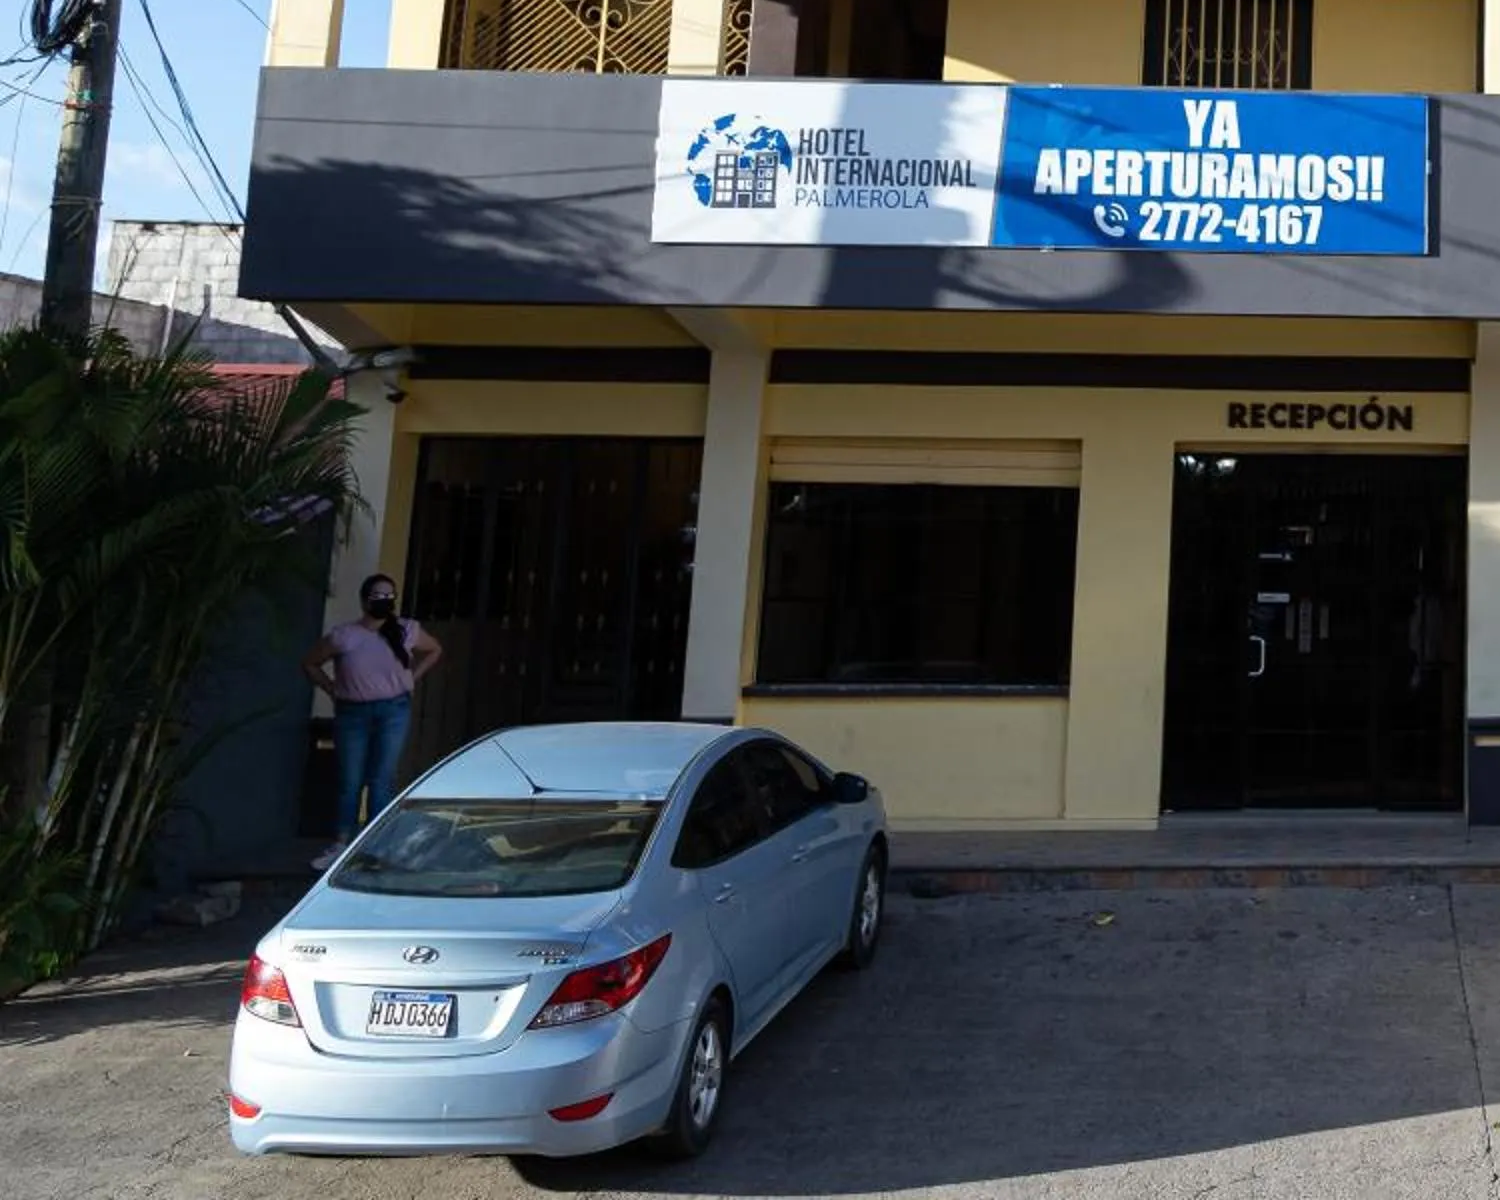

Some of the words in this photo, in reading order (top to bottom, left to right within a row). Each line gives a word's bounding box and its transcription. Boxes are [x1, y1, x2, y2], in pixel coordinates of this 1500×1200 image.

[799, 127, 872, 157] HOTEL
[1183, 99, 1242, 149] YA
[795, 157, 977, 188] INTERNACIONAL
[1034, 148, 1385, 202] APERTURAMOS!!
[794, 186, 930, 210] PALMEROLA
[1138, 201, 1324, 246] 2772-4167
[1227, 395, 1414, 432] RECEPCIÓN
